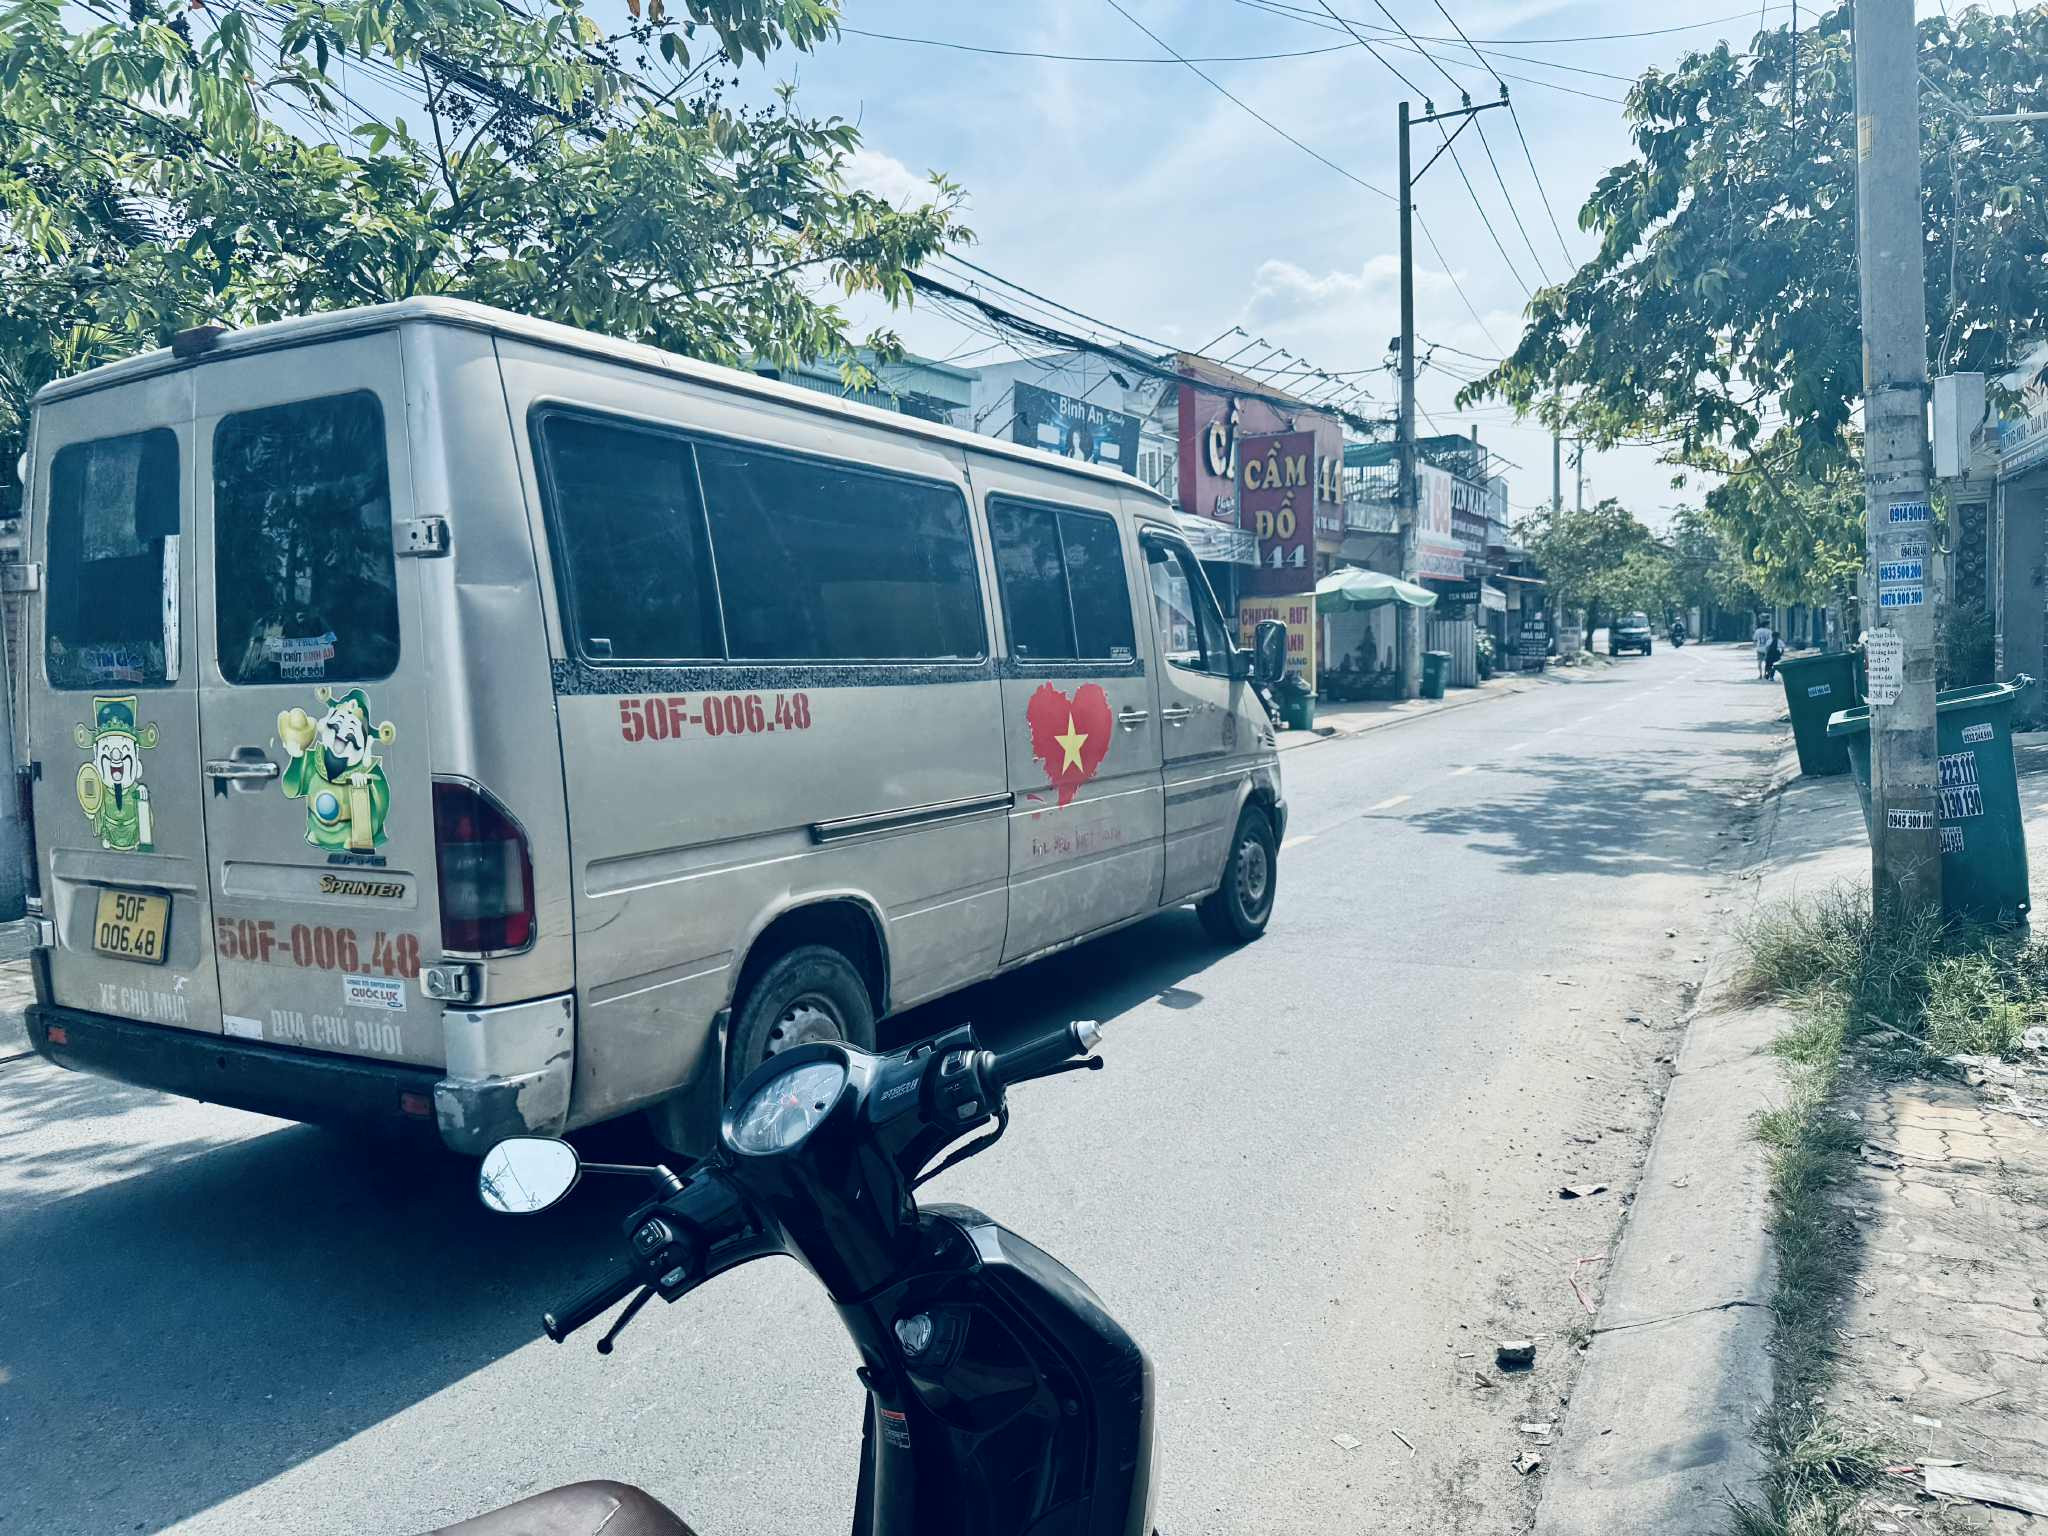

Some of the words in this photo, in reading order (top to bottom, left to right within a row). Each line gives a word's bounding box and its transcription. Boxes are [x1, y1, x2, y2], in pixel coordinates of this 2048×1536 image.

[1087, 406, 1104, 425] An
[1243, 441, 1308, 490] CẦM
[1255, 490, 1297, 541] ĐỒ
[1265, 543, 1308, 569] 44
[619, 692, 811, 742] 50F-006.48
[115, 894, 147, 923] 50F
[100, 922, 156, 956] 006.48
[217, 916, 421, 979] 50F-006.48
[99, 981, 117, 1011] XE
